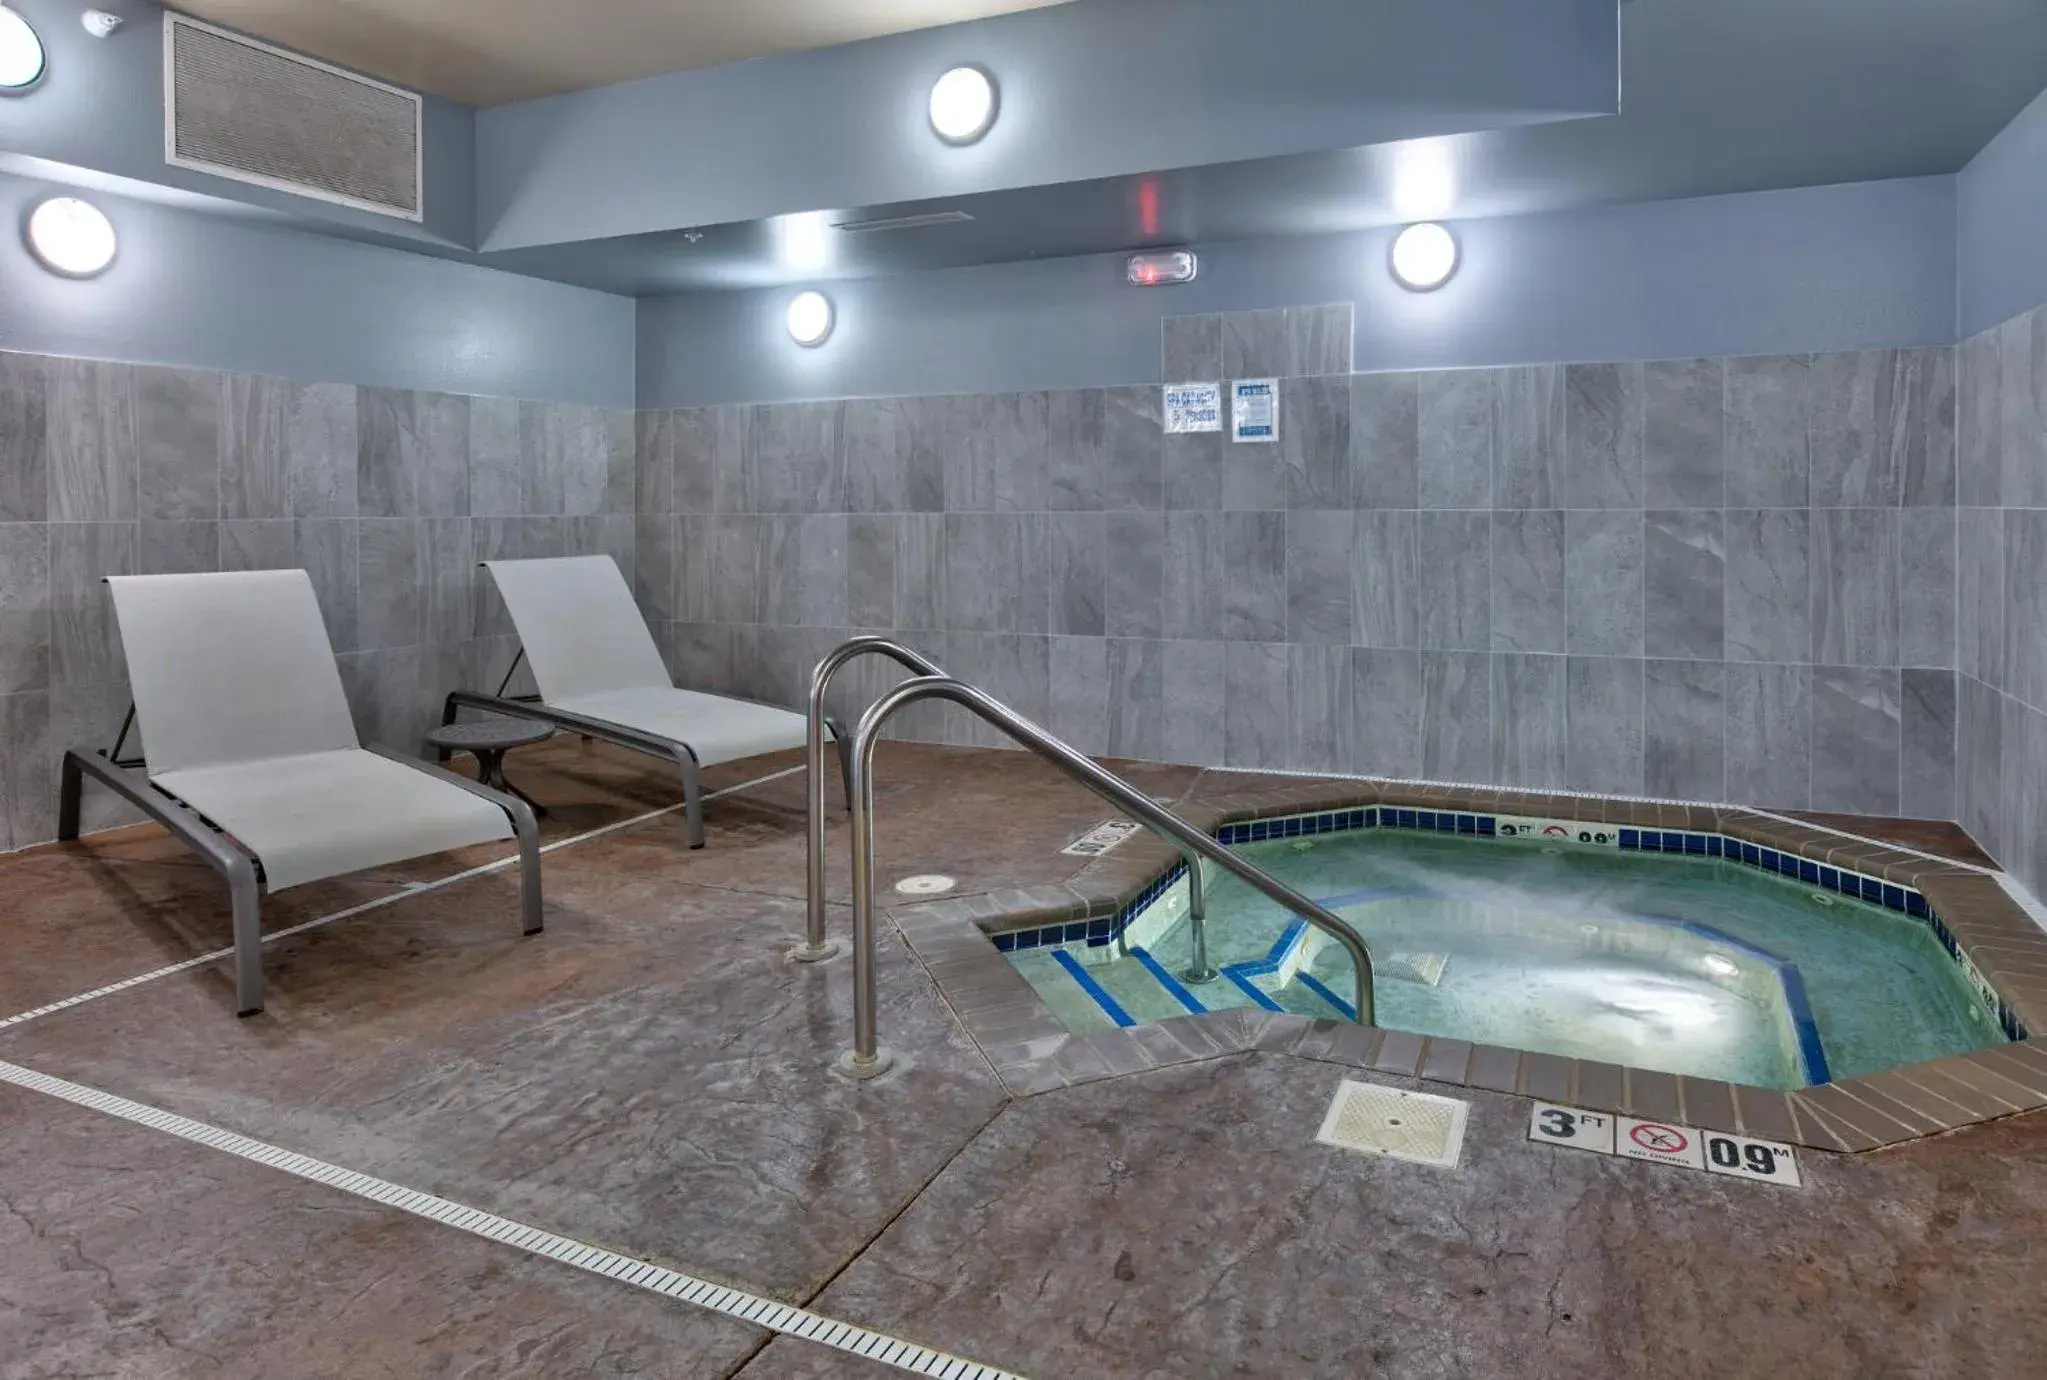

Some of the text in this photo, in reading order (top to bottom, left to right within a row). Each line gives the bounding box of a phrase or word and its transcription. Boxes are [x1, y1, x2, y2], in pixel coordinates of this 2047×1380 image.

[1539, 1109, 1576, 1138] 3
[1580, 1114, 1607, 1129] FT
[1773, 1147, 1790, 1159] M
